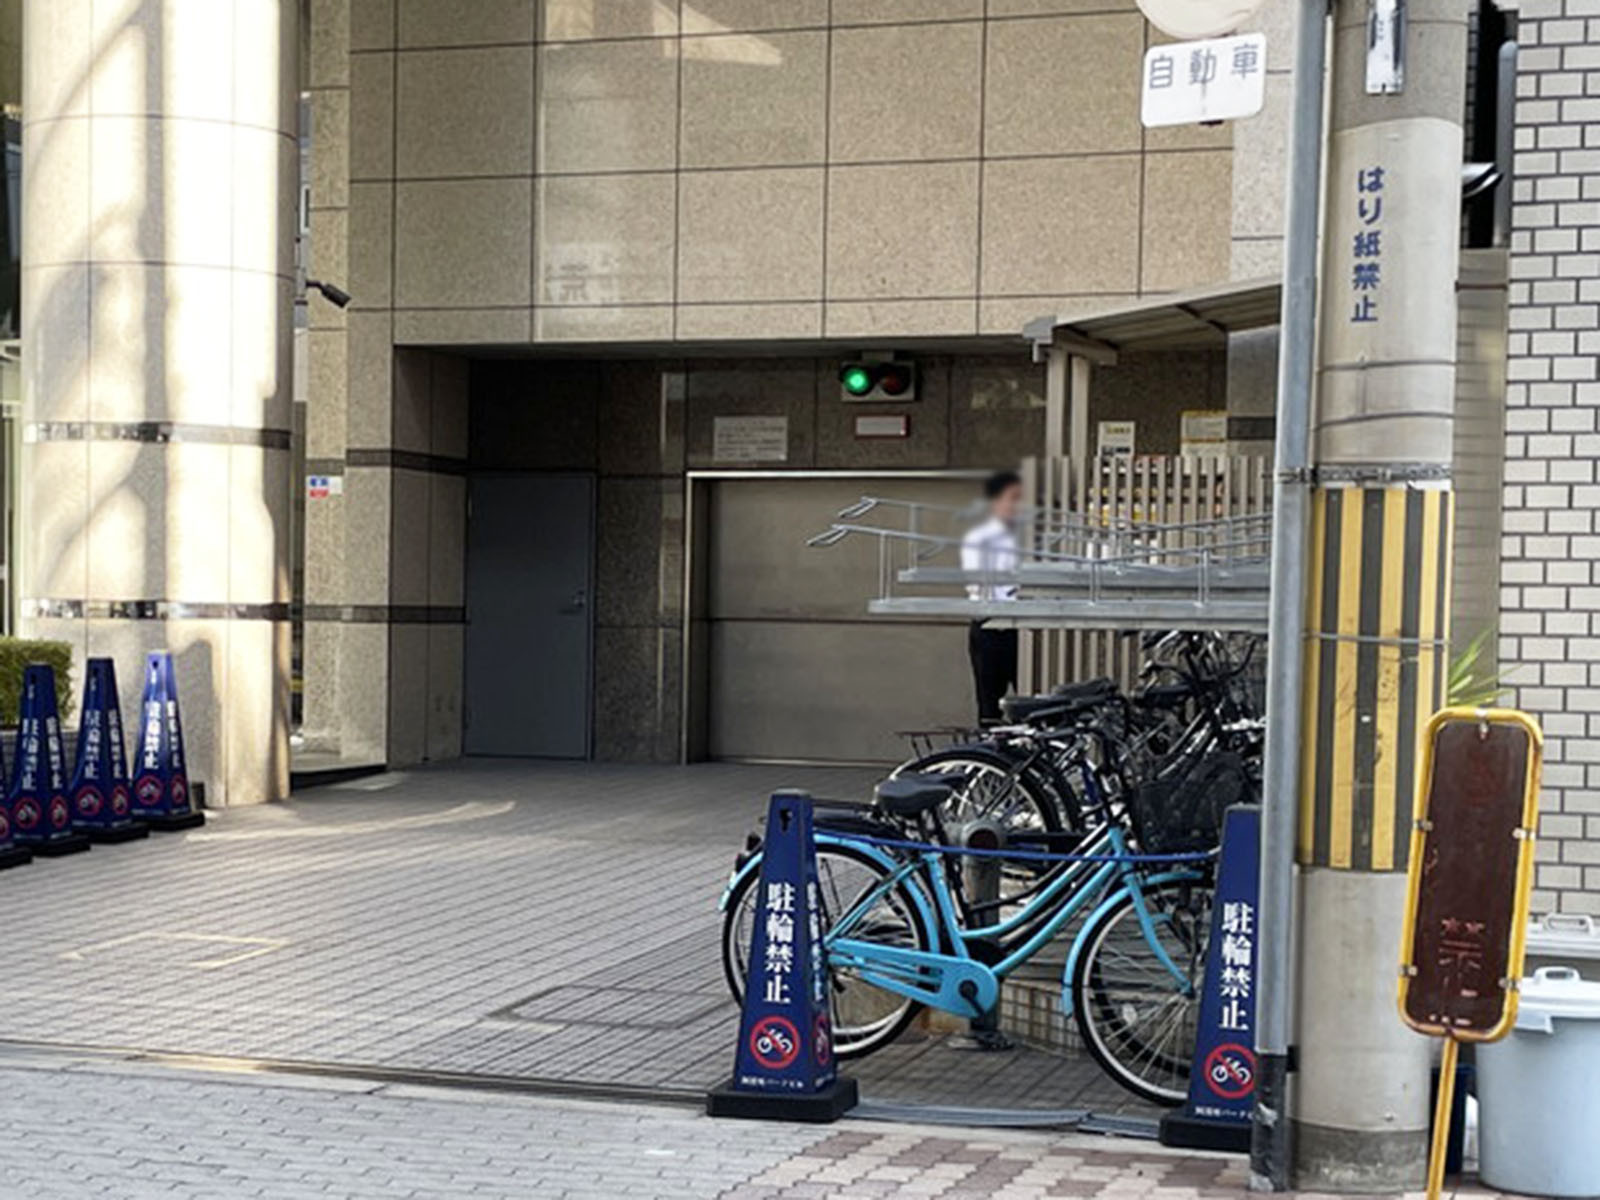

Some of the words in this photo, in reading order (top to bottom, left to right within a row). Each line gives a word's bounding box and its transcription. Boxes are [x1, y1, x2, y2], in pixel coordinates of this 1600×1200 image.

[1148, 43, 1260, 90] 自動車
[1350, 165, 1386, 324] はり紙禁止
[765, 882, 796, 1004] 駐輪禁止
[1220, 902, 1253, 1031] 駐輪禁止
